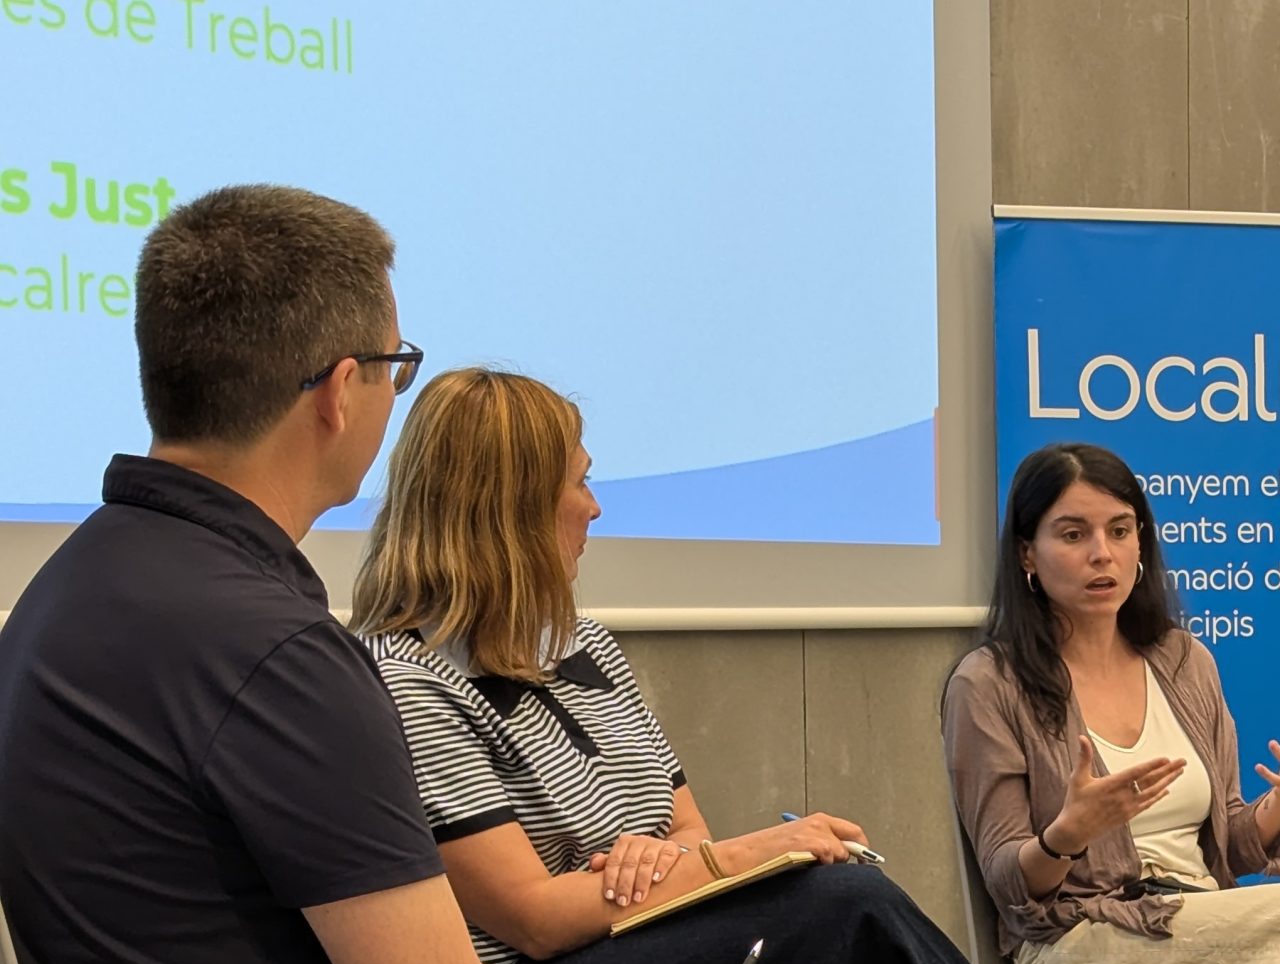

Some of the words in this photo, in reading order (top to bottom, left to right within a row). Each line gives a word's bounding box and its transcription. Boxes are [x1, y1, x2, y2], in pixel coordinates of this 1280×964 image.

[177, 0, 353, 74] Treball
[49, 161, 176, 227] Just
[0, 253, 138, 317] calre
[1154, 516, 1227, 543] ents
[1237, 521, 1273, 543] en
